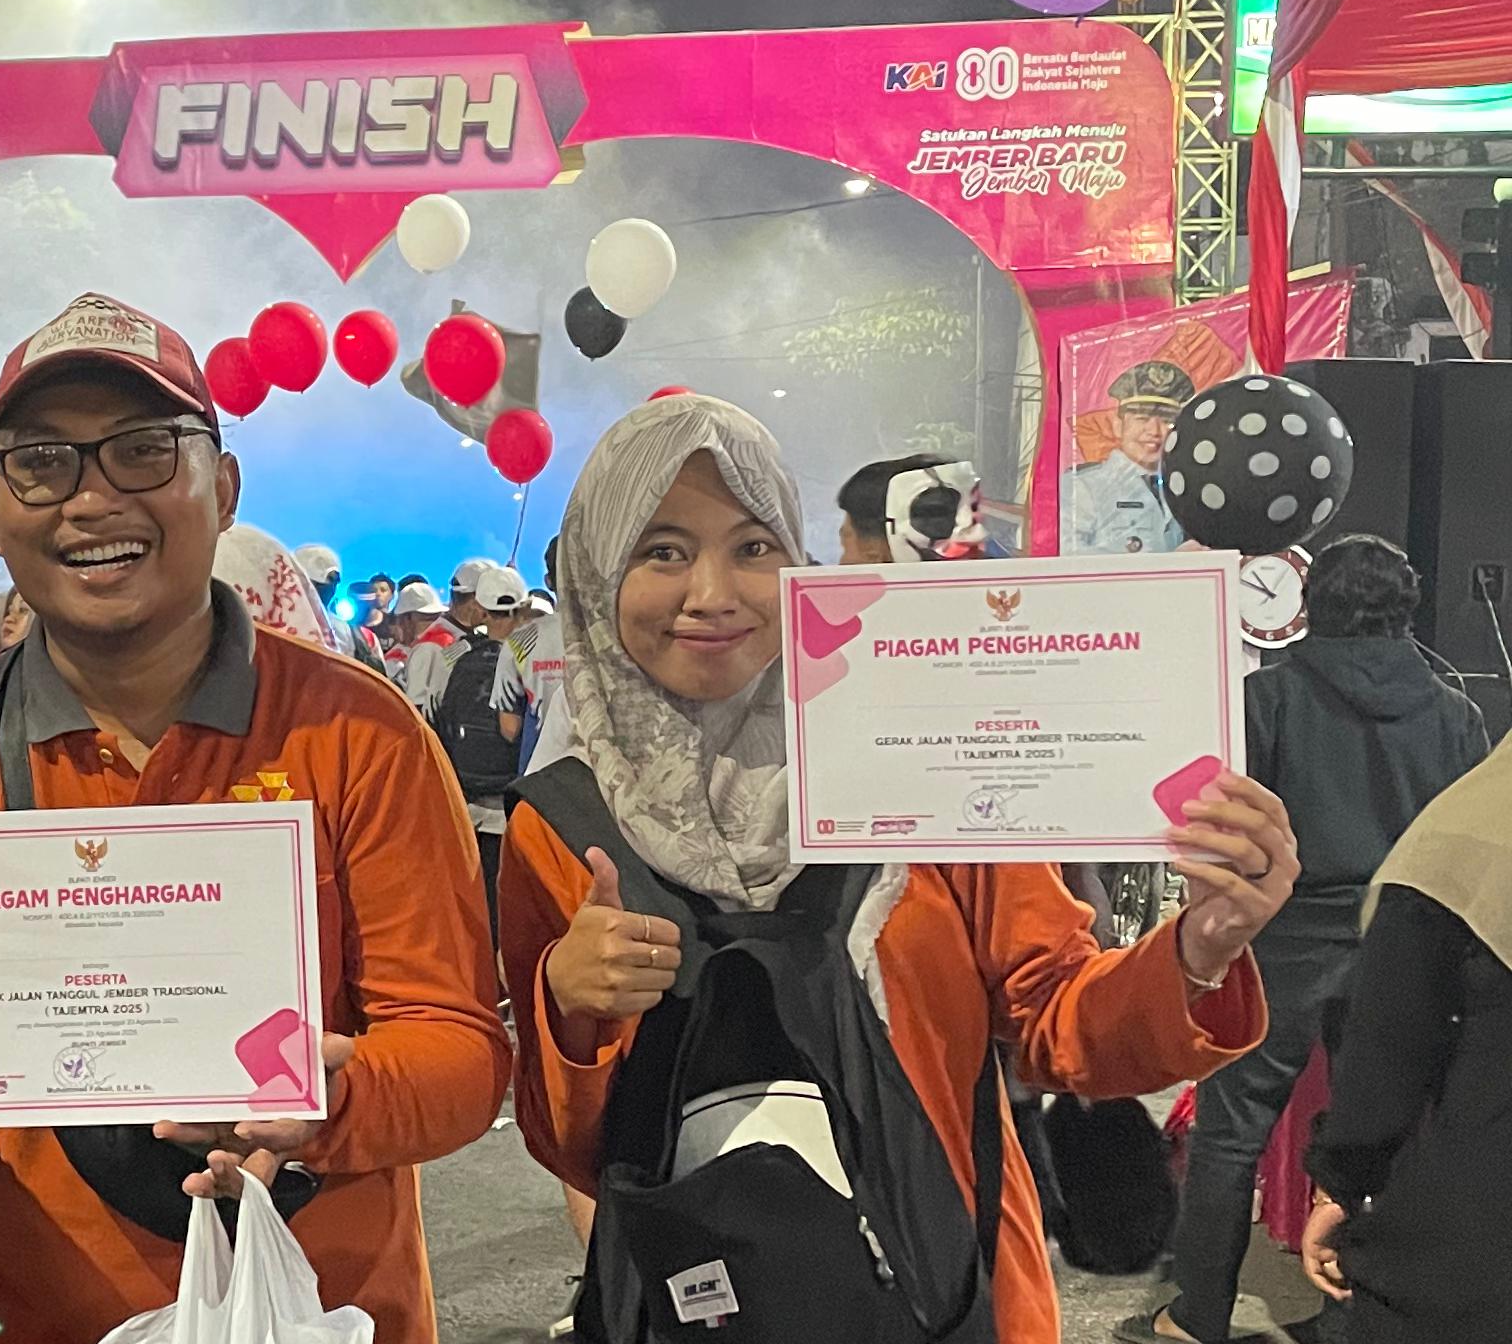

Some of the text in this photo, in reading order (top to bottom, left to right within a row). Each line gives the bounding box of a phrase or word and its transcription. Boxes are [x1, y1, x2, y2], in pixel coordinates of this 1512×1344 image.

[885, 46, 1019, 101] KAI 80
[1023, 64, 1121, 80] Rakyat Sejahtera
[1022, 77, 1108, 92] Indonesia Maju
[153, 74, 519, 168] FINISH
[920, 123, 1127, 143] Satukan Langkah Menuju
[909, 143, 1126, 172] JEMBER BARU
[963, 166, 1125, 199] Jember Maju
[76, 316, 106, 327] ARE
[874, 632, 1140, 657] PIAGAM PENGHARGAAN
[975, 720, 1040, 732] PESERTA
[875, 732, 1146, 746] GERAK JALAN TANGGUL JEMBER TRADISIONAL
[963, 750, 1021, 760] TAJEMTRA
[1025, 749, 1056, 759] 2025
[57, 883, 222, 908] PENGHARGAAN
[64, 974, 128, 987] PESERTA
[7, 991, 42, 1002] JALAN
[45, 989, 100, 1000] TANGGUL
[103, 987, 149, 999] JEMBER
[153, 985, 228, 997] TRADISIONAL
[52, 1005, 109, 1016] TAJEMTRA
[112, 1003, 143, 1014] 2025
